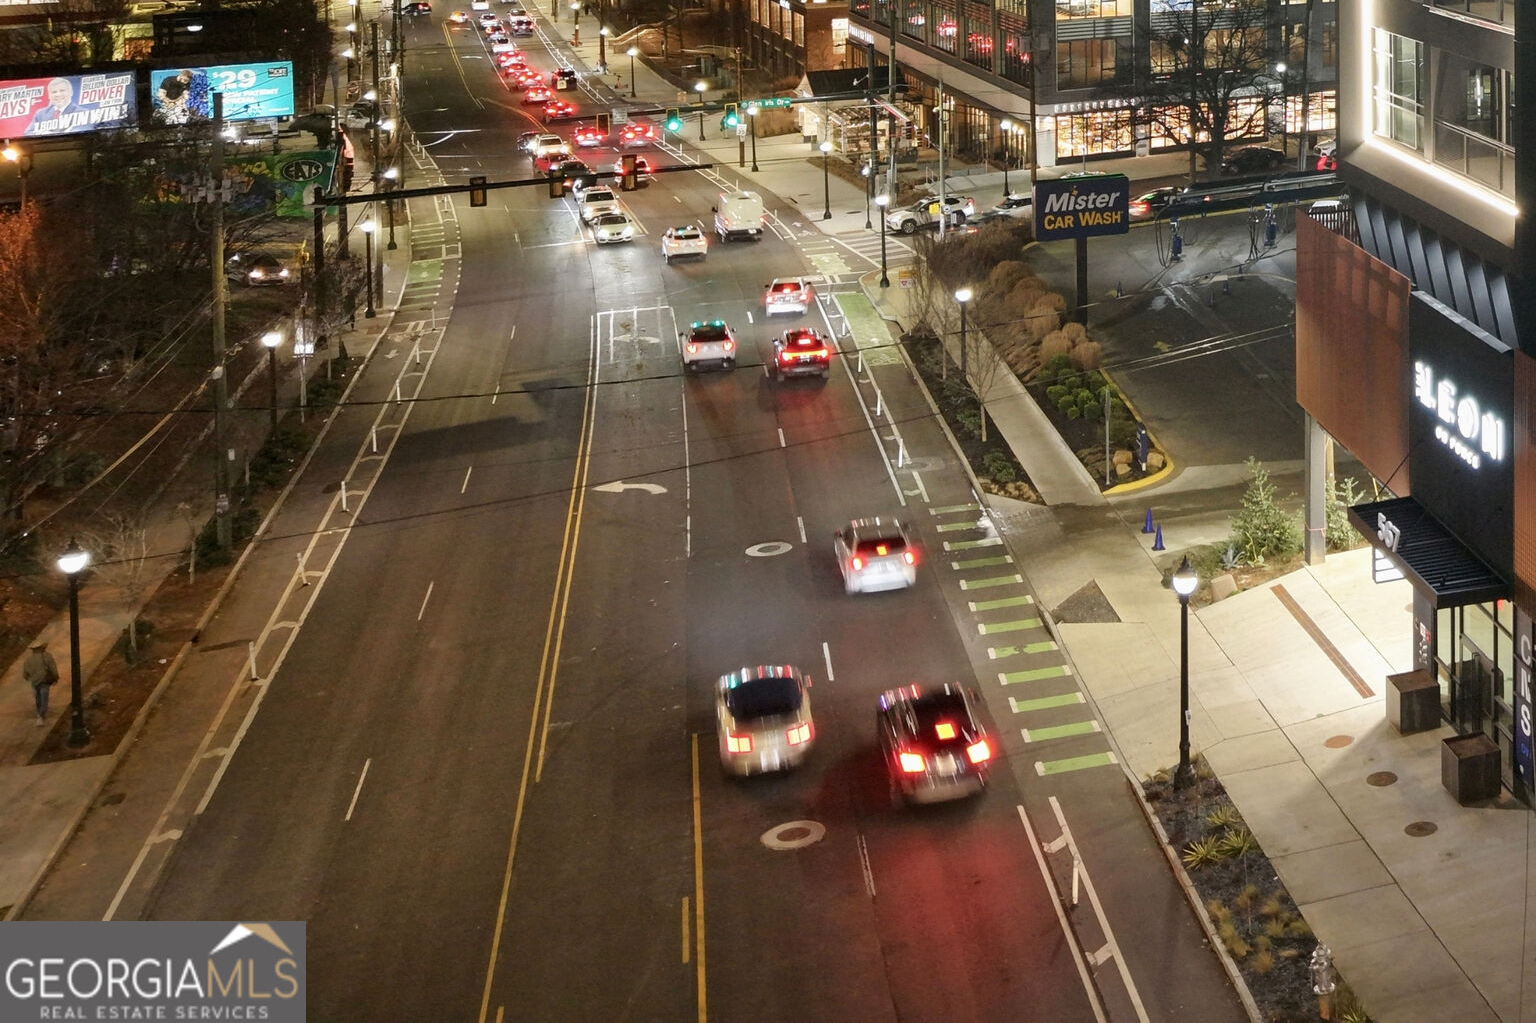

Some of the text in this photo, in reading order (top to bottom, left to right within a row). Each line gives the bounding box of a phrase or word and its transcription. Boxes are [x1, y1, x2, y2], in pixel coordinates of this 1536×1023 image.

[82, 77, 130, 90] BILLION DOLLAR
[212, 69, 257, 90] $29
[13, 88, 43, 100] MARTIN
[81, 85, 124, 103] POWER
[0, 99, 27, 118] AYS
[283, 161, 321, 179] EATS
[1045, 187, 1121, 213] Mister
[1044, 211, 1121, 230] CAR WASH
[1423, 365, 1504, 461] LEON
[1378, 512, 1400, 552] 567
